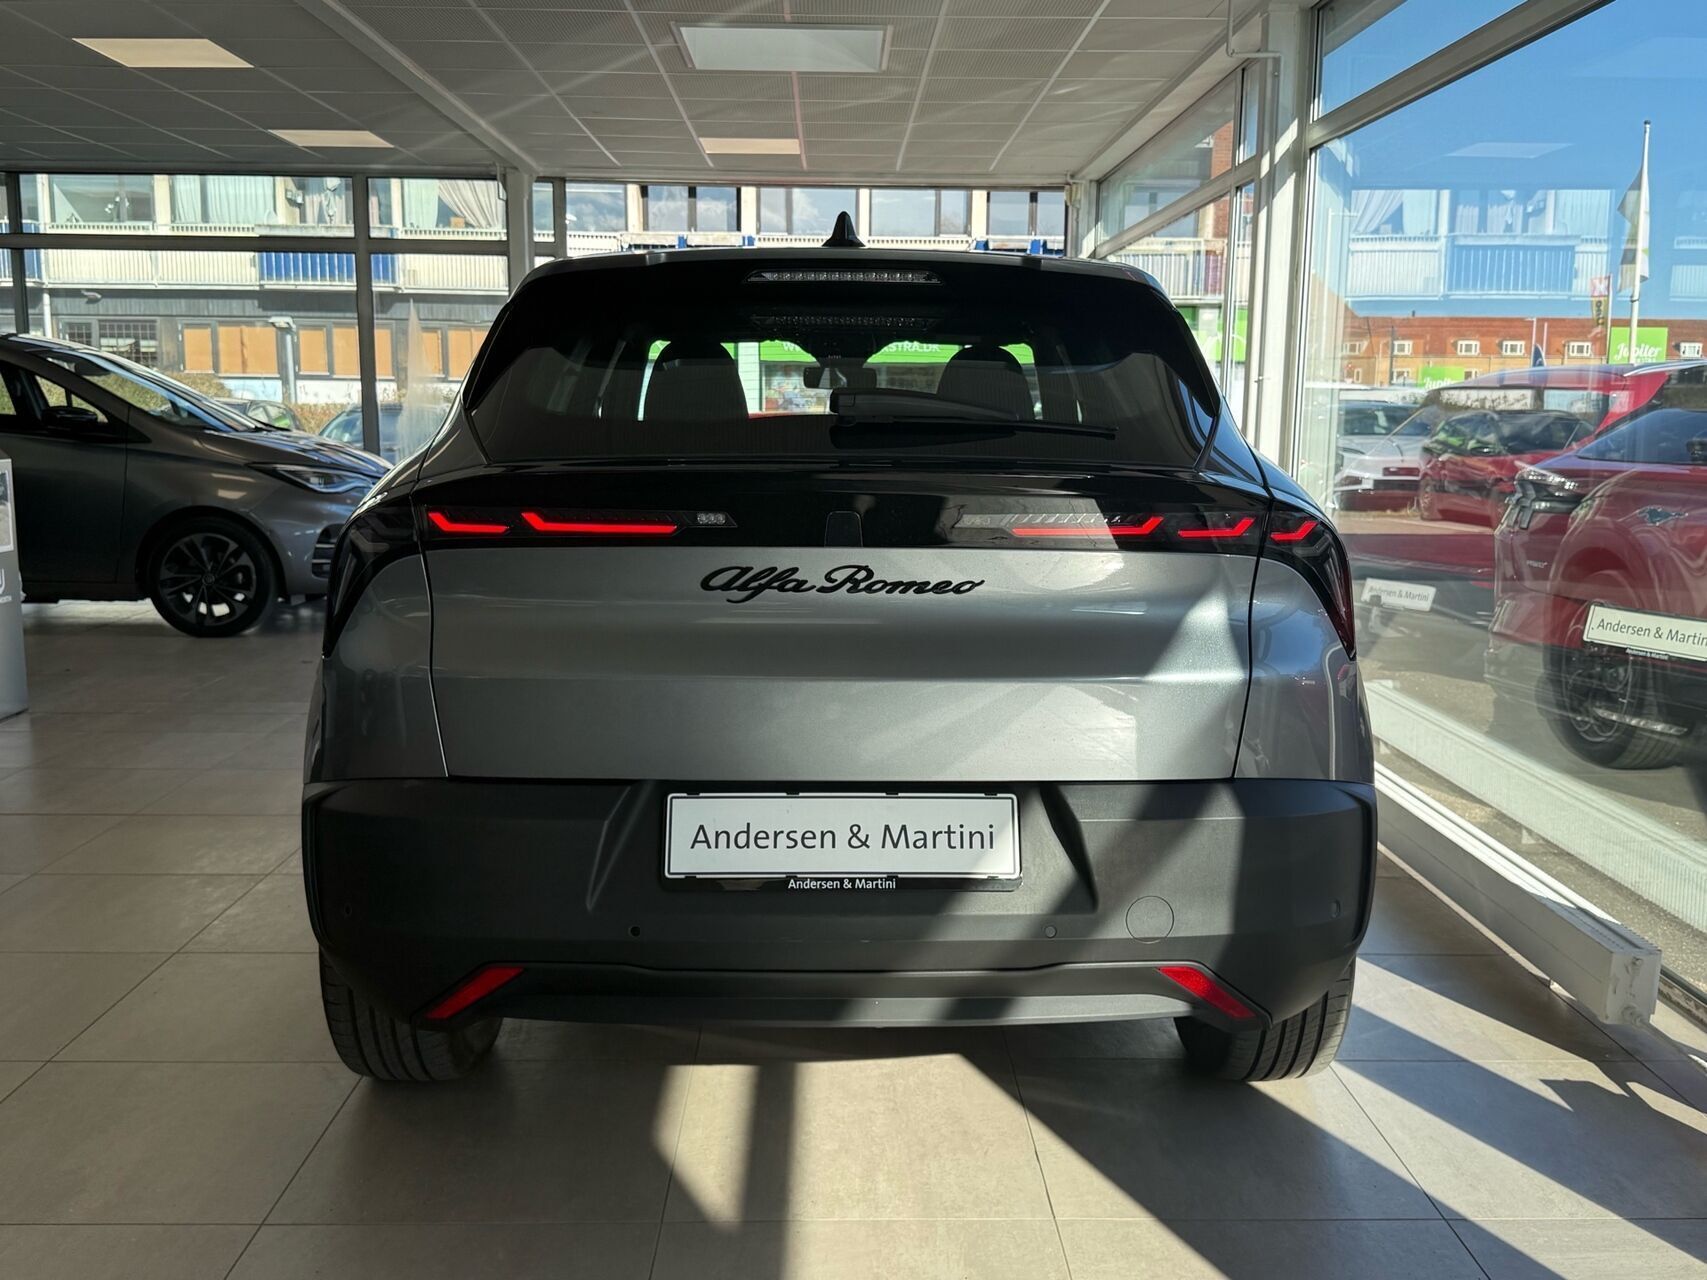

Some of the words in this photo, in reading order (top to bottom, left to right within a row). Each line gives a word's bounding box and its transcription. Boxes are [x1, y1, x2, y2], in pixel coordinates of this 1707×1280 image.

[700, 565, 816, 604] Alfa
[815, 564, 985, 595] Romeo
[1403, 590, 1430, 602] Martini
[1597, 618, 1651, 637] Andersen
[1653, 626, 1664, 639] &
[1666, 628, 1707, 647] Martin
[690, 822, 837, 850] Andersen
[847, 823, 871, 850] &
[881, 823, 995, 850] Martini
[787, 878, 841, 890] Andersen
[843, 879, 852, 890] &
[854, 878, 897, 890] Martini
